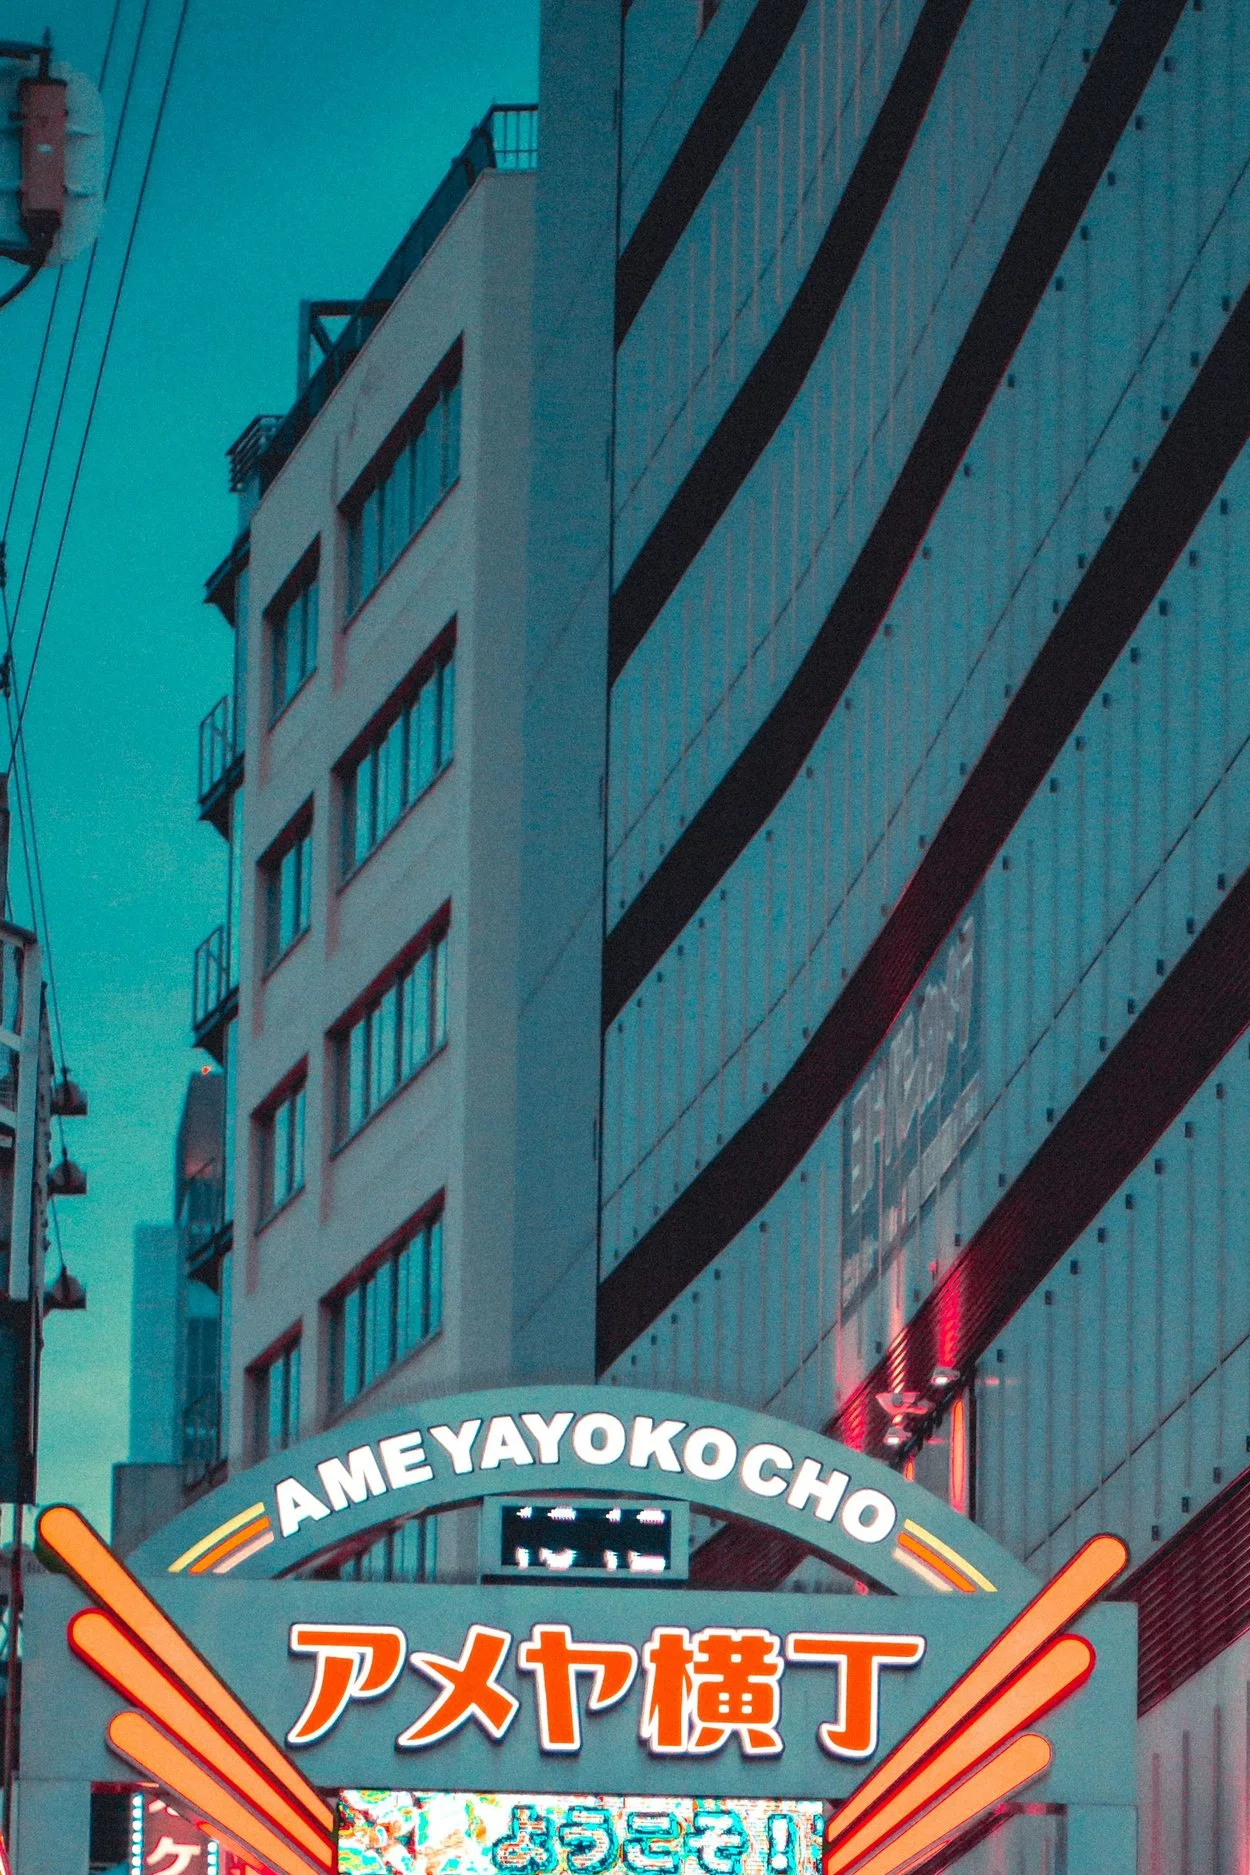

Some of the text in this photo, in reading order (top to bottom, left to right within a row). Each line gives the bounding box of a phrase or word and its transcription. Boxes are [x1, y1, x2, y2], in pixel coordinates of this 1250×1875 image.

[286, 1622, 927, 1761] アメヤ横丁
